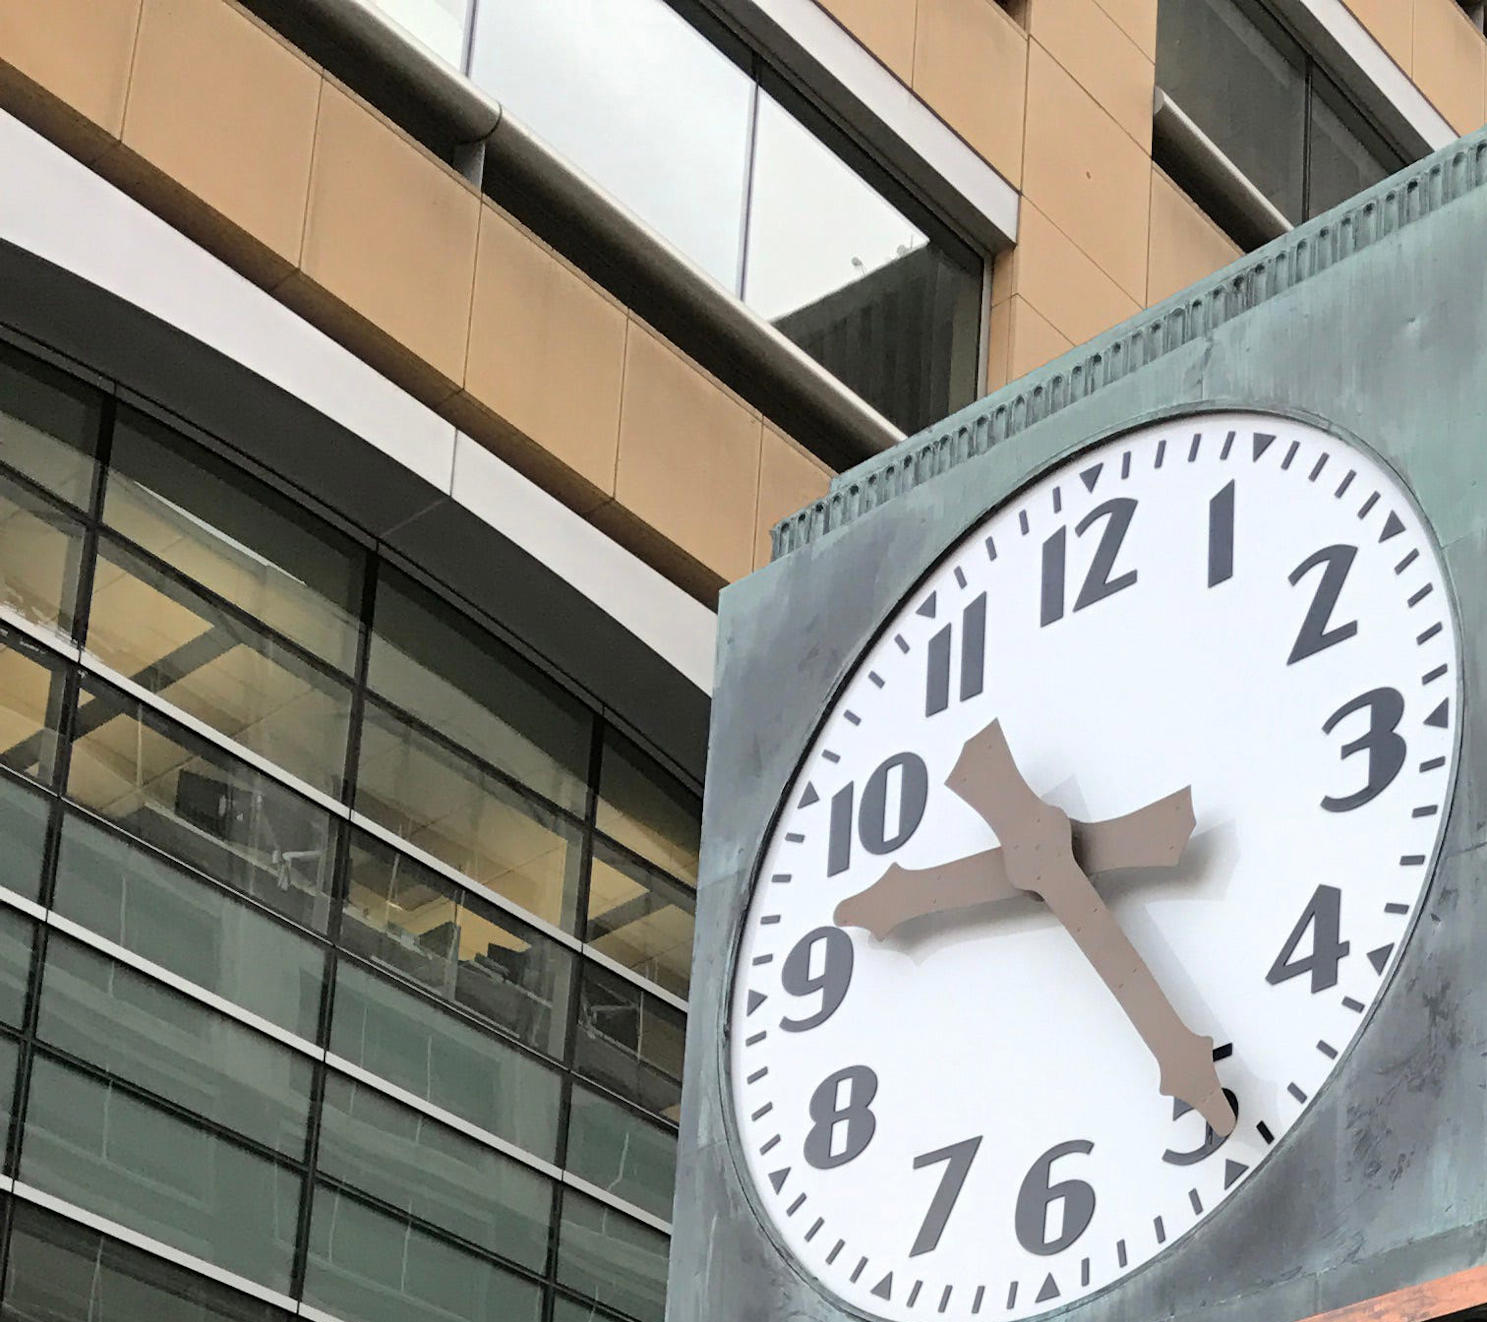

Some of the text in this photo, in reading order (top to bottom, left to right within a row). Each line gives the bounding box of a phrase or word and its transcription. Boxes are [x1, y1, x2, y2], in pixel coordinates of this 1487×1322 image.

[1040, 496, 1139, 628] 12
[1208, 479, 1236, 589] 1
[924, 590, 988, 718] 11
[1287, 542, 1360, 666] 2
[1320, 687, 1407, 814] 3
[826, 750, 930, 878] 10
[778, 924, 855, 1034] 9
[1264, 883, 1351, 995] 4
[803, 1064, 879, 1172] 8
[908, 1134, 985, 1259] 7
[1013, 1138, 1097, 1257] 6
